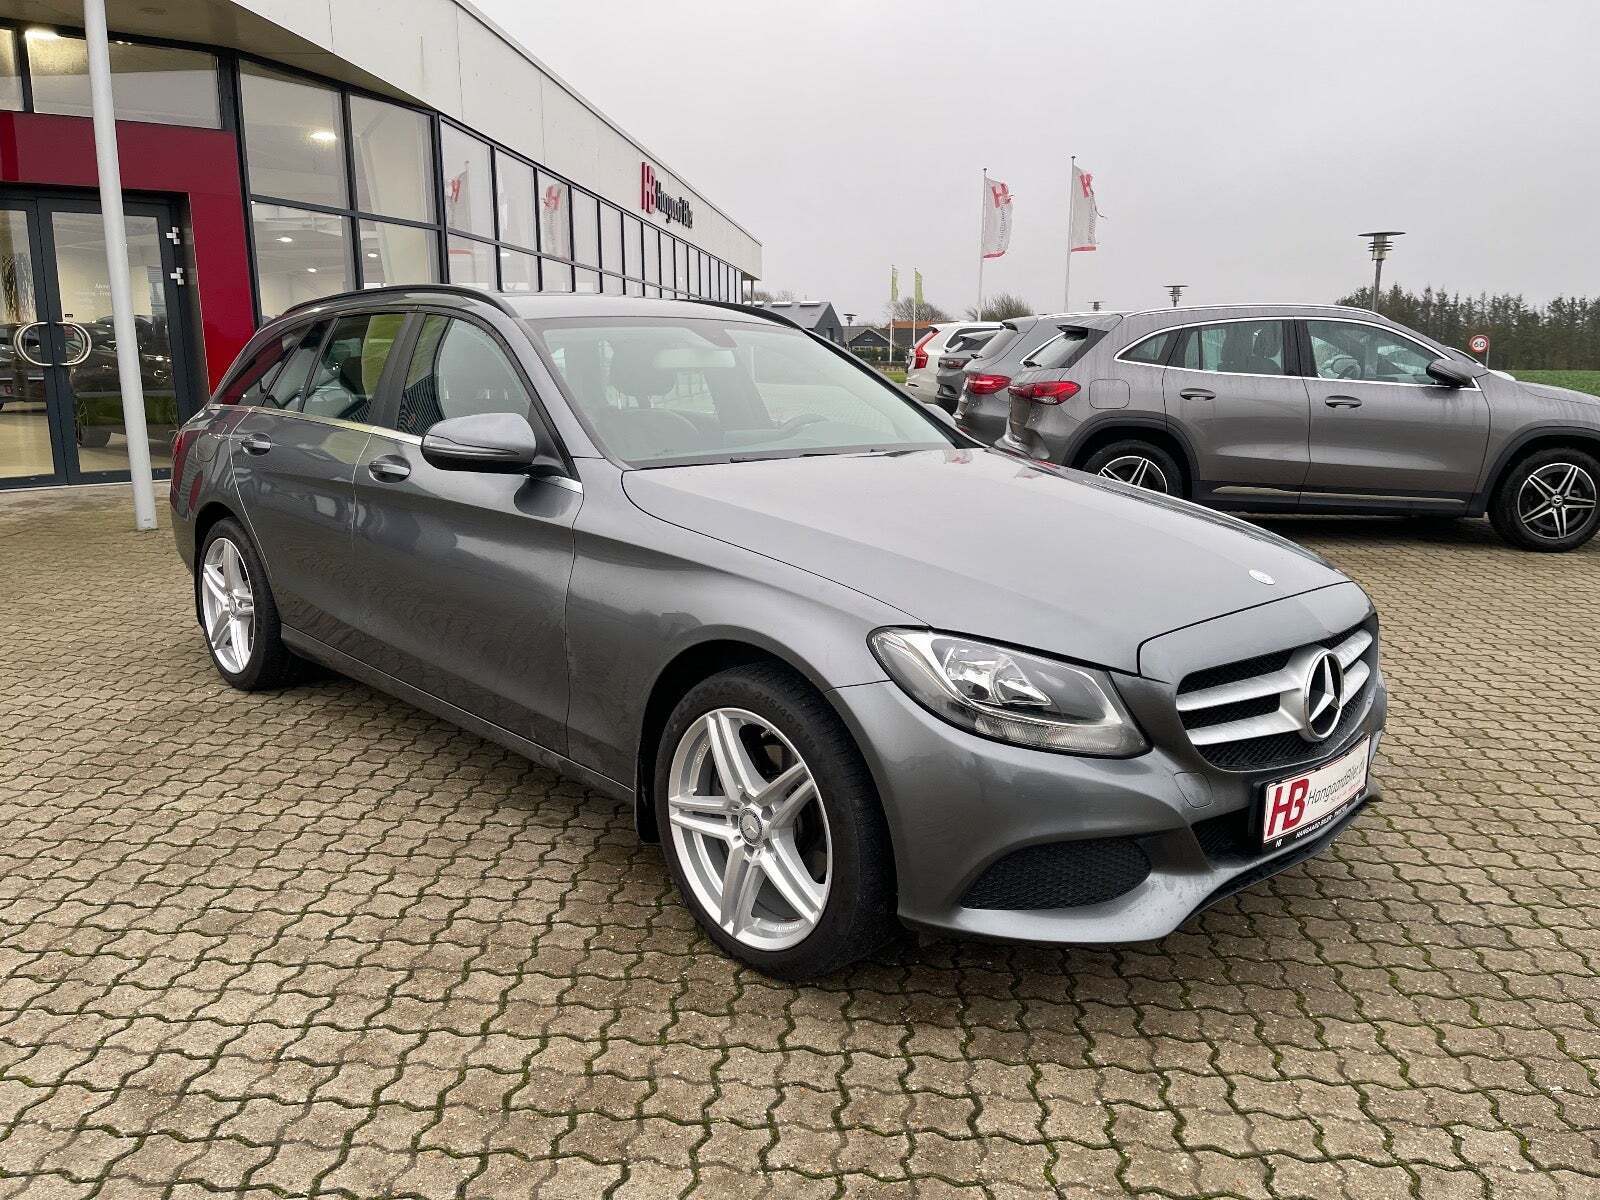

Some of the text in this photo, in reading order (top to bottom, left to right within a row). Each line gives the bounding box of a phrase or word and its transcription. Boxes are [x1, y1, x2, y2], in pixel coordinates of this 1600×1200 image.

[641, 162, 656, 214] HB
[655, 180, 682, 224] Hangd
[1267, 779, 1309, 837] HB
